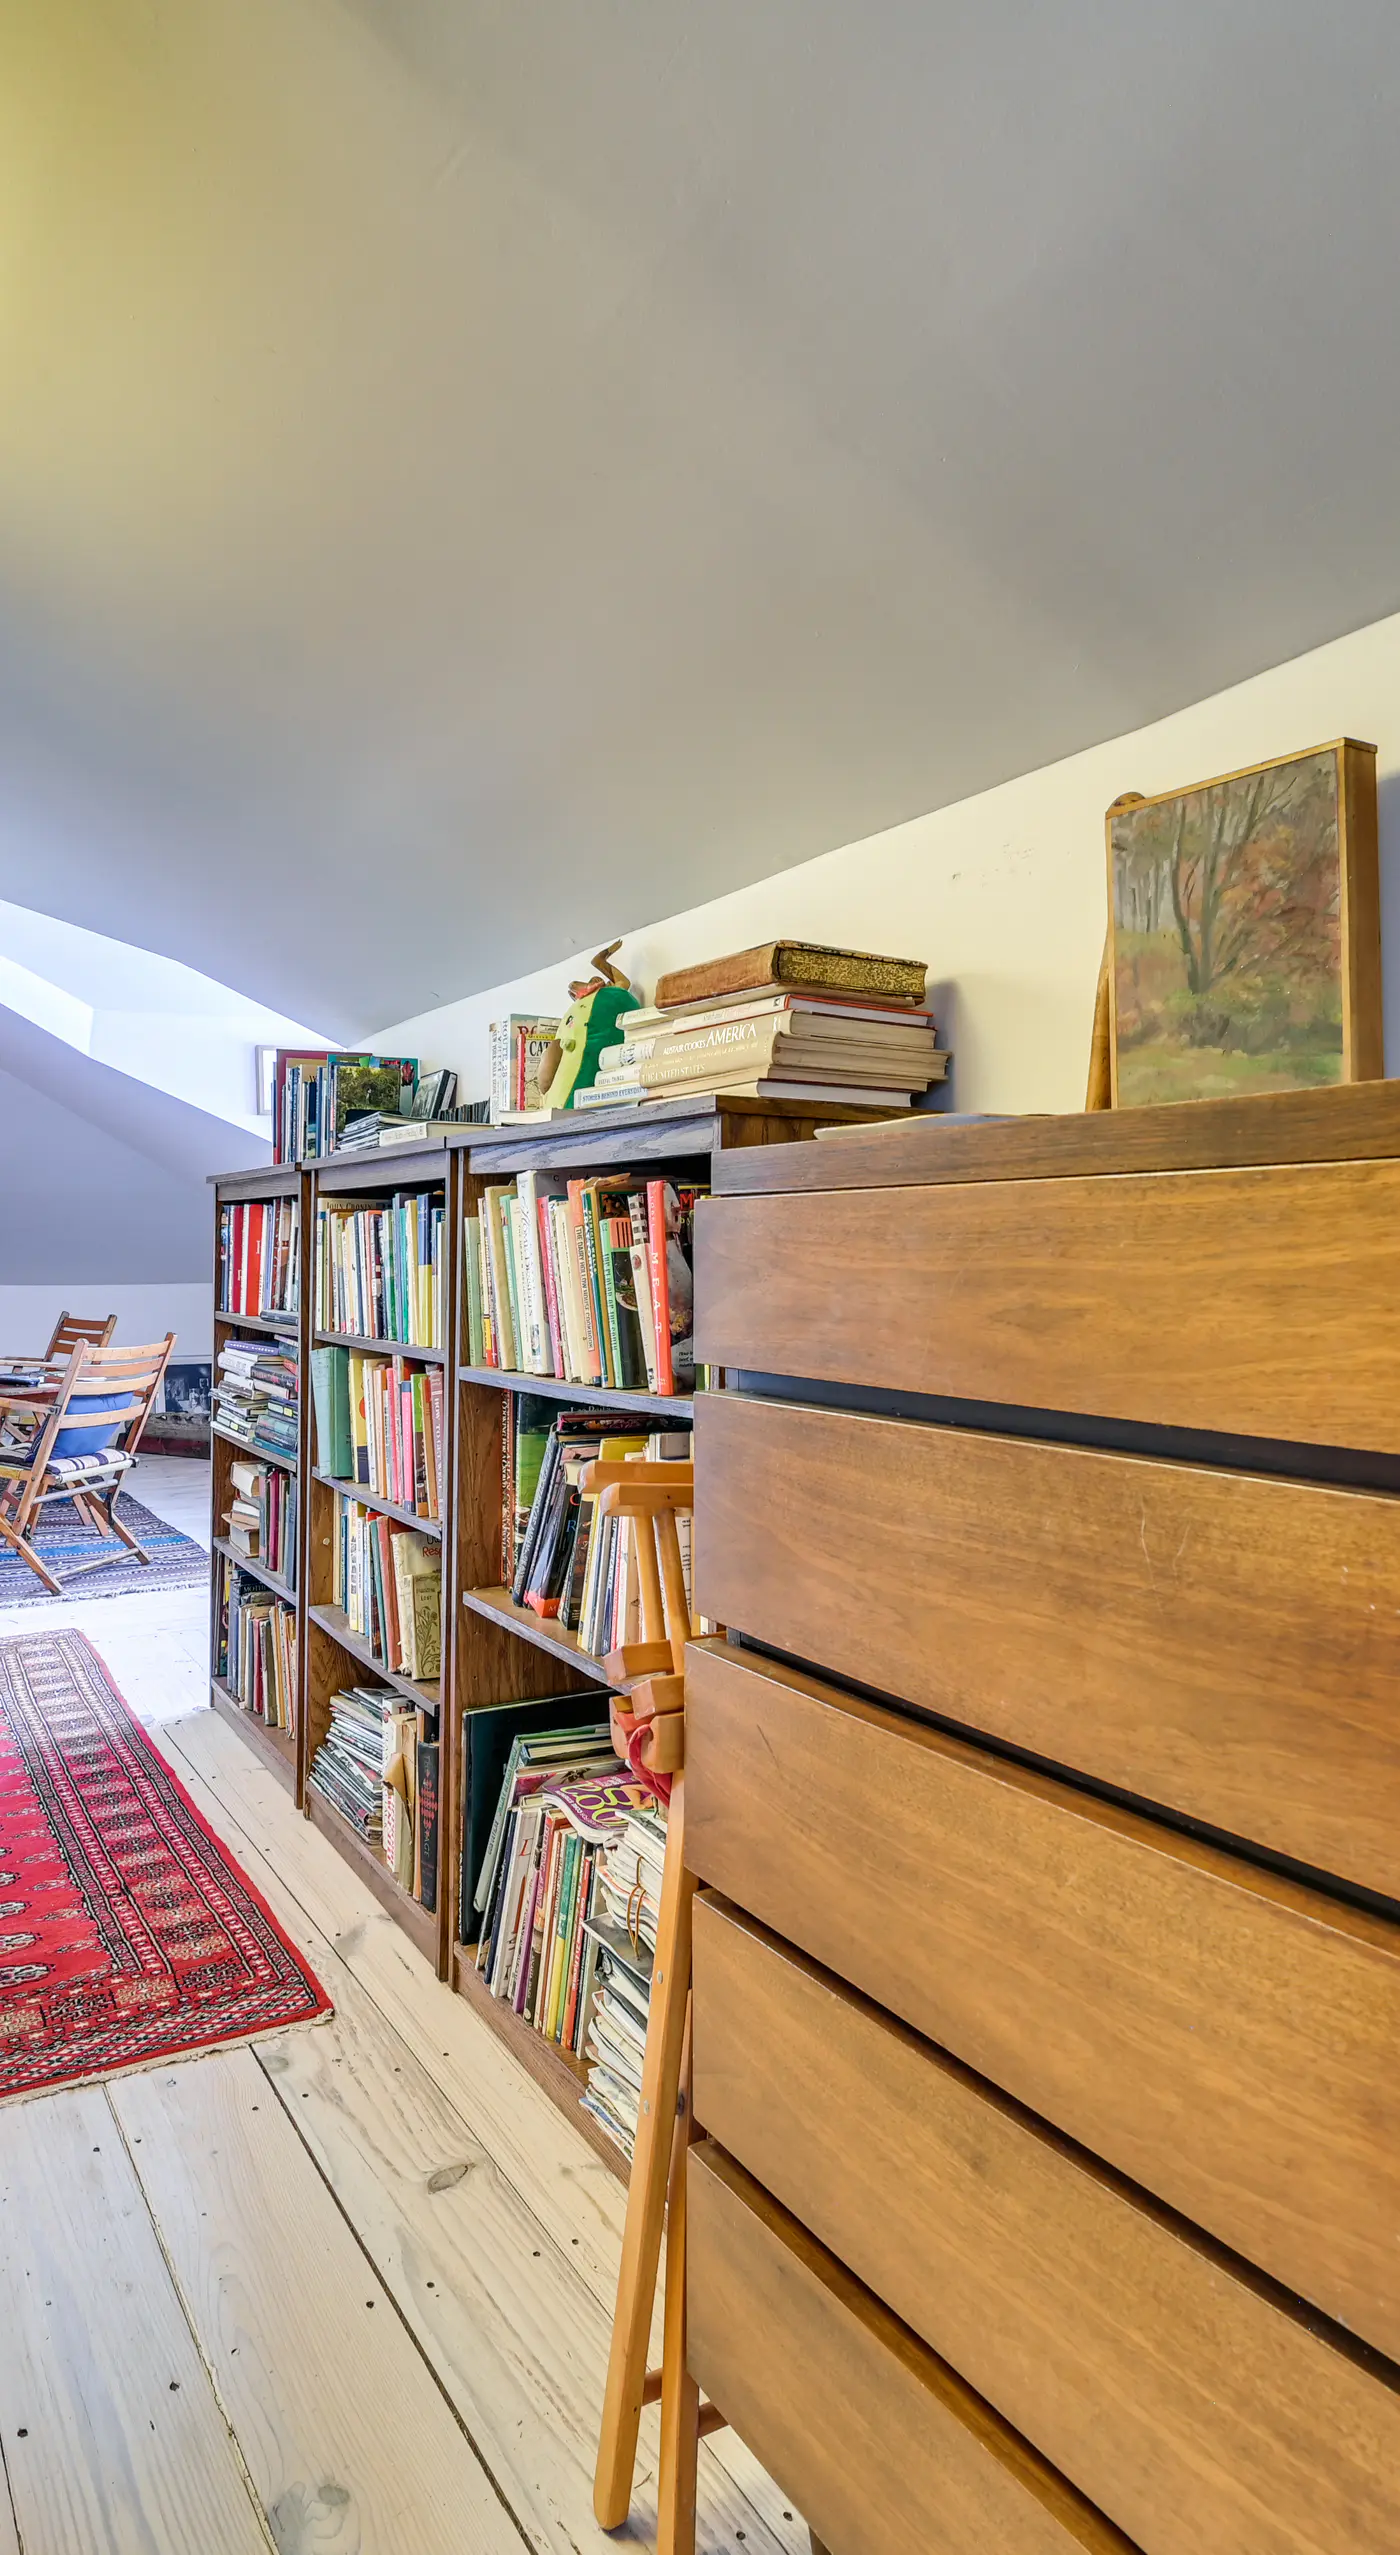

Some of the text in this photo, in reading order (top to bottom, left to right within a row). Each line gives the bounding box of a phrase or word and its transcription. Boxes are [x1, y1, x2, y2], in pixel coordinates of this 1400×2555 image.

[706, 1023, 757, 1048] AMERICA
[583, 1086, 642, 1102] STORIES BEHIND EVERYDAY
[577, 1240, 585, 1259] DAIRY
[582, 1290, 590, 1311] HOUSE
[584, 1312, 594, 1349] COOKBOOK
[435, 1423, 442, 1437] TO
[436, 1462, 444, 1489] WELL
